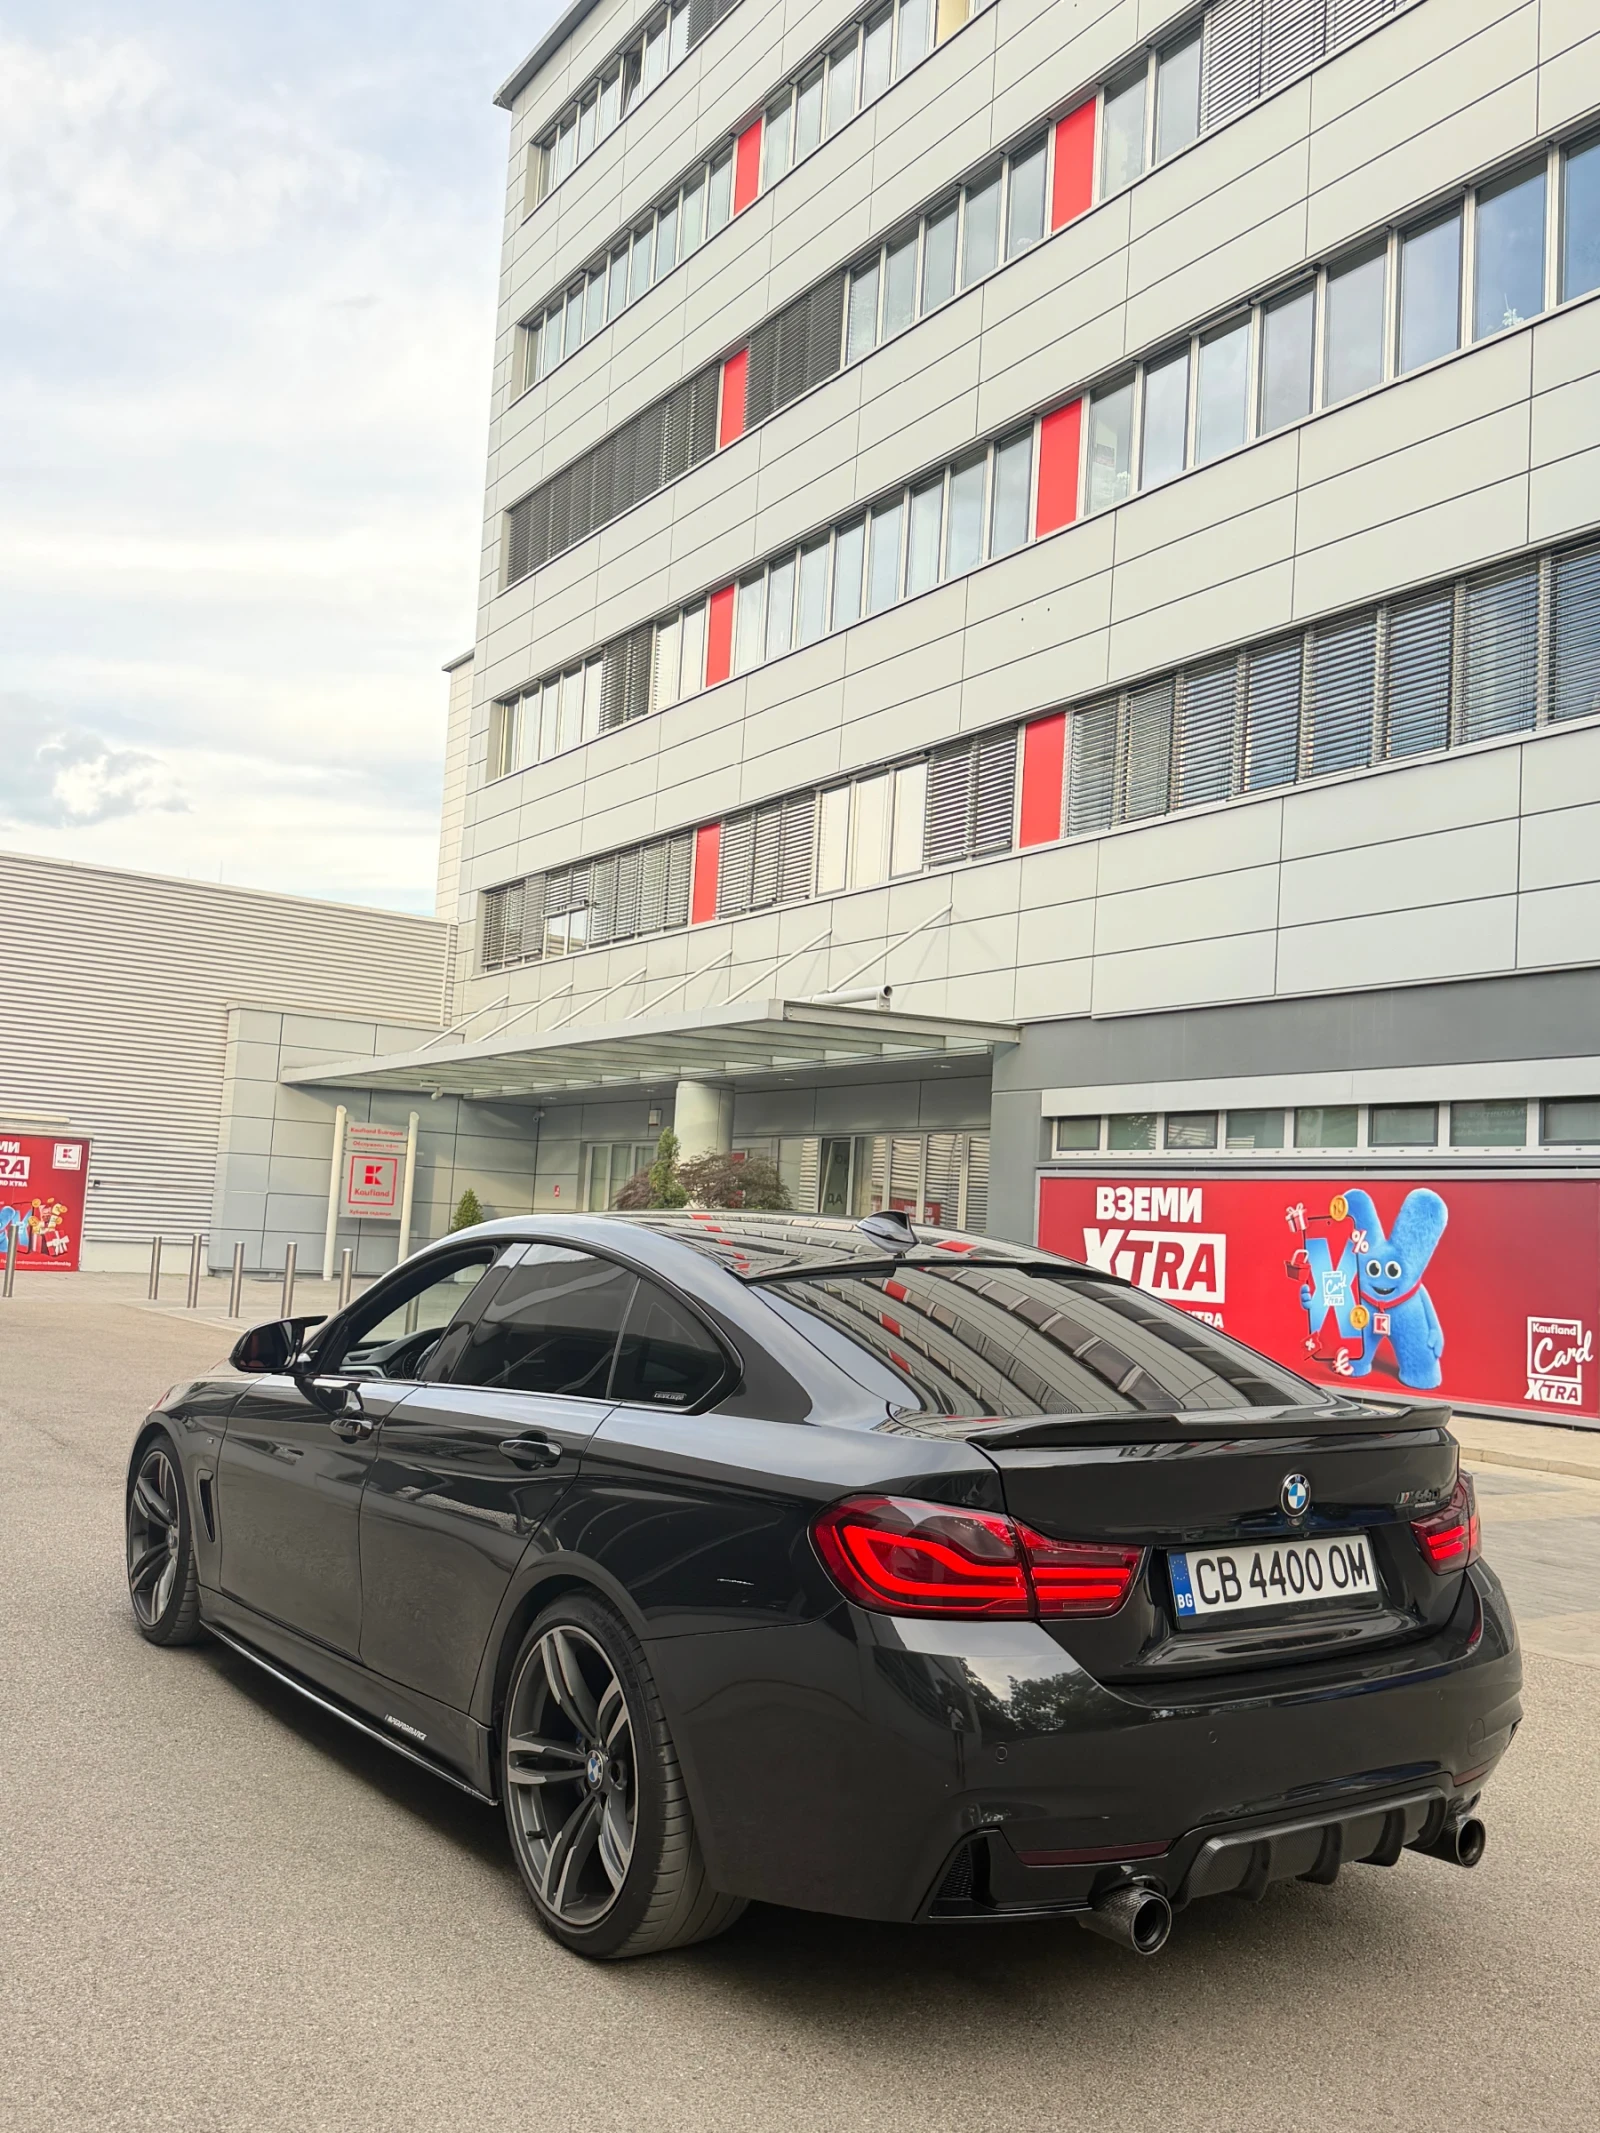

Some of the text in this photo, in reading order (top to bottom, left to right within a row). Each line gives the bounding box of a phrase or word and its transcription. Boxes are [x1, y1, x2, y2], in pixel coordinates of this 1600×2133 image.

[354, 1188, 390, 1197] Kaufland
[1096, 1186, 1203, 1223] ВЗЕМИ
[1083, 1228, 1225, 1302] XTRA
[1532, 1322, 1576, 1336] Kaufland
[1534, 1330, 1594, 1373] Card
[1524, 1378, 1582, 1405] XTRA
[1249, 1547, 1324, 1597] 4400
[1177, 1593, 1193, 1608] BG
